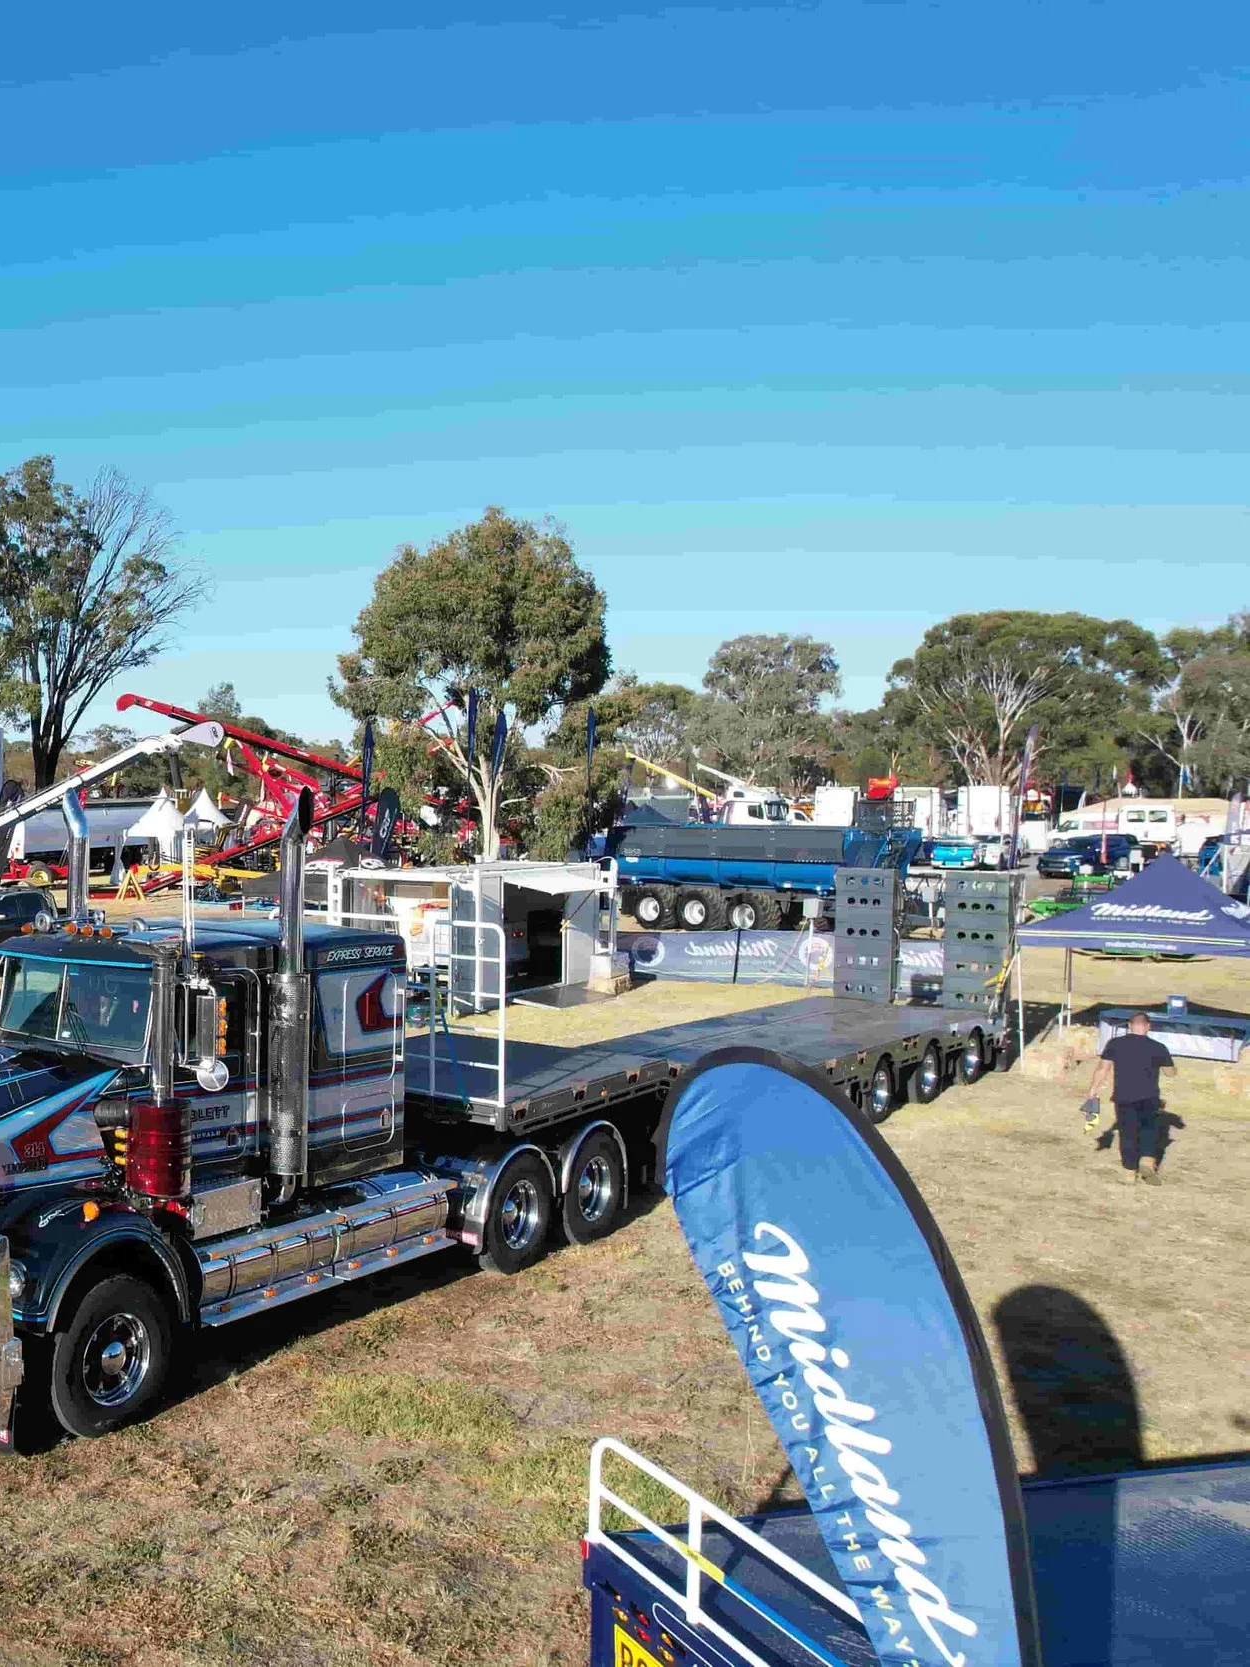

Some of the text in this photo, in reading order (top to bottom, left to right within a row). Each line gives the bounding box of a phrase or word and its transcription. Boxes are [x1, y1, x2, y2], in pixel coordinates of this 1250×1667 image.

[1090, 902, 1215, 921] Midland
[326, 945, 396, 962] EXPRESS SERVICE
[24, 1141, 46, 1158] 314
[717, 1260, 773, 1363] BEHIND
[772, 1372, 811, 1431] YOU
[805, 1445, 838, 1501] ALL
[837, 1511, 873, 1572] THE
[742, 1221, 978, 1667] Midland
